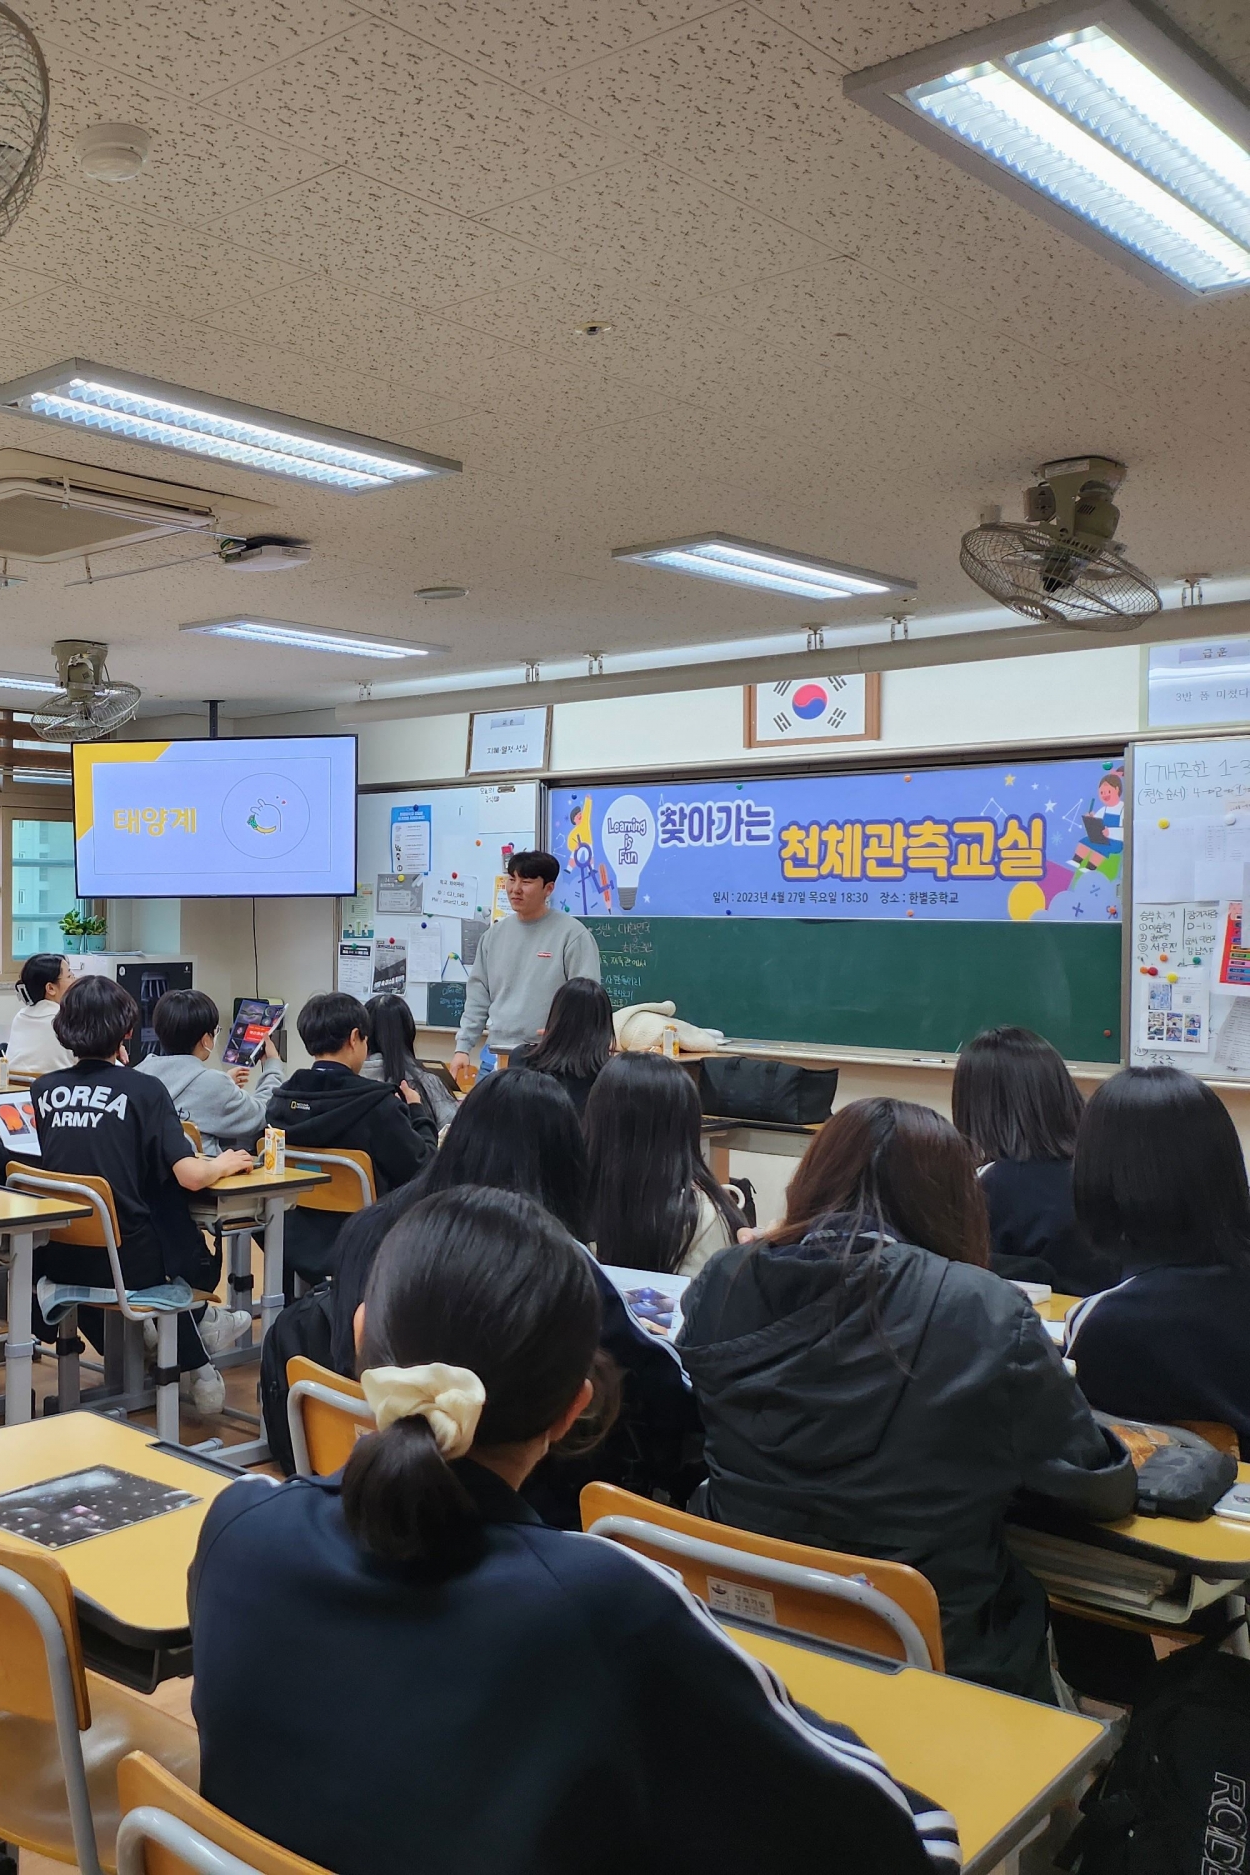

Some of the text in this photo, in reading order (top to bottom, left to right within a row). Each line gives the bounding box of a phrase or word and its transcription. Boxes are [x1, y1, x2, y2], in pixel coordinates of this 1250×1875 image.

[1175, 691, 1192, 703] 3반
[113, 806, 197, 837] 태양계
[607, 817, 647, 836] Learning
[658, 801, 773, 847] 찾아가는
[623, 834, 634, 851] is
[779, 815, 1046, 880] 천체관측교실
[618, 848, 639, 865] Fun
[712, 891, 729, 904] 일시
[736, 891, 768, 904] 2023년
[770, 891, 785, 904] 4월
[787, 891, 806, 904] 27일
[808, 890, 837, 904] 목요일
[840, 891, 869, 903] 18:30
[879, 891, 900, 905] 장소
[908, 890, 960, 905] 한별중학교
[37, 1085, 128, 1120] KOREA
[51, 1111, 104, 1128] ARMY
